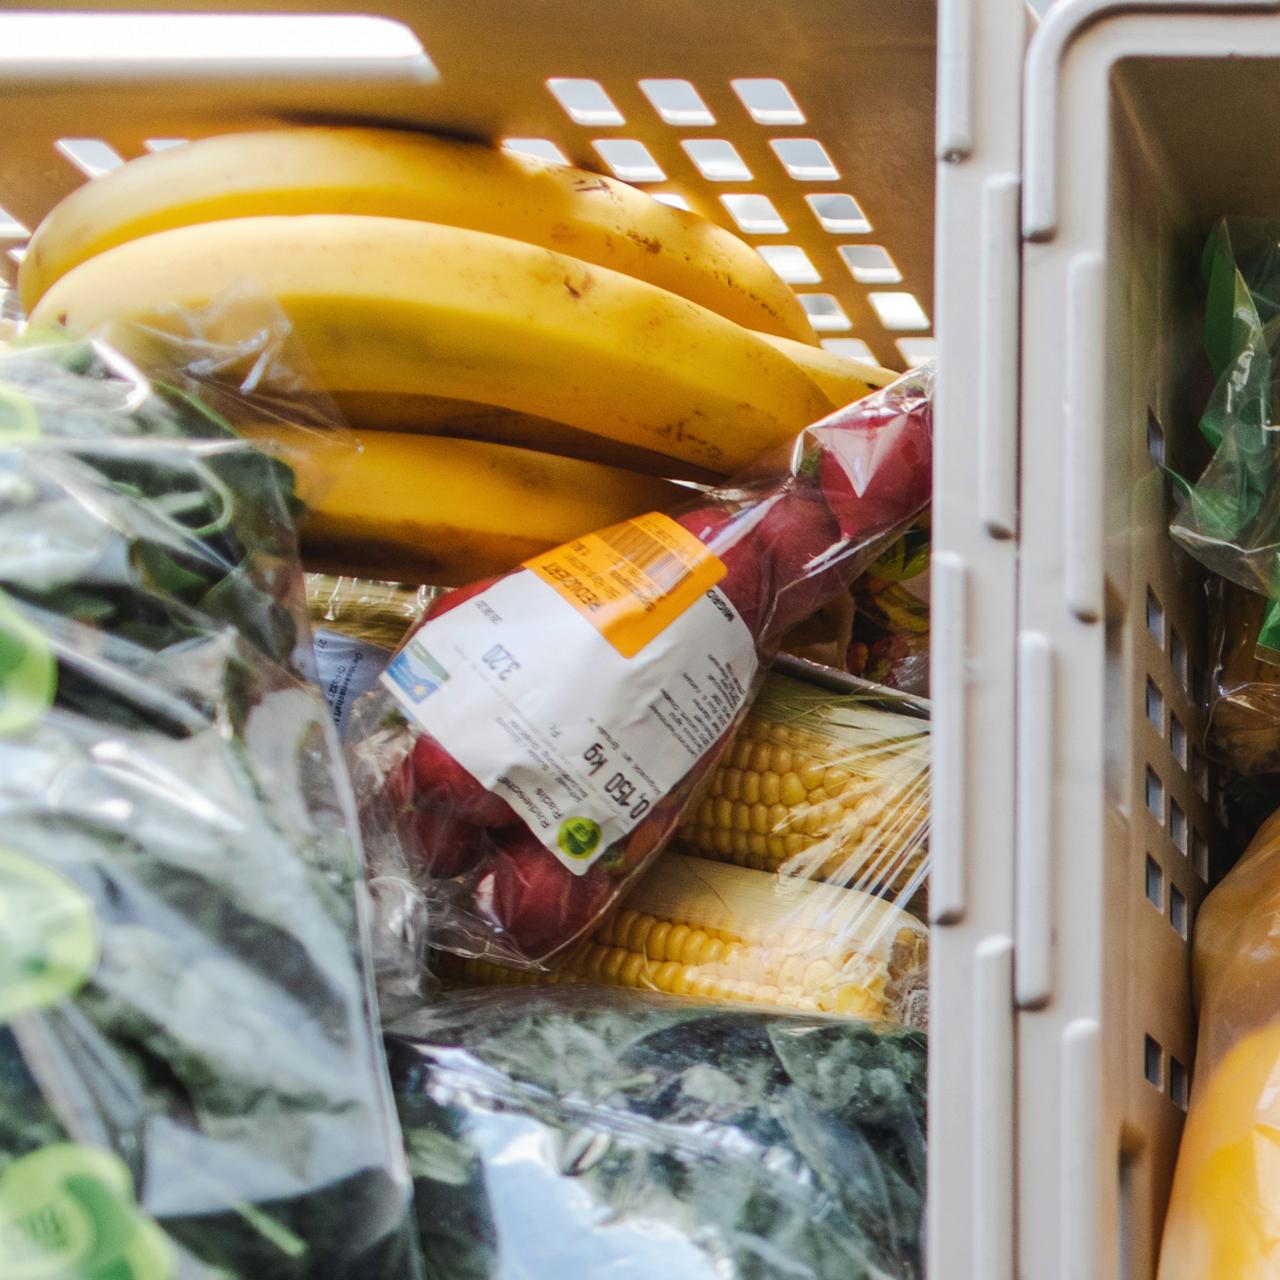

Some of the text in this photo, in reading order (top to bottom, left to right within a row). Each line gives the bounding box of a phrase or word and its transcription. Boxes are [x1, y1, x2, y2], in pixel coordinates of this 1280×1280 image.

[541, 557, 601, 612] REDUZIERT
[703, 586, 736, 622] MIGRO
[574, 740, 653, 821] 0,150 kg
